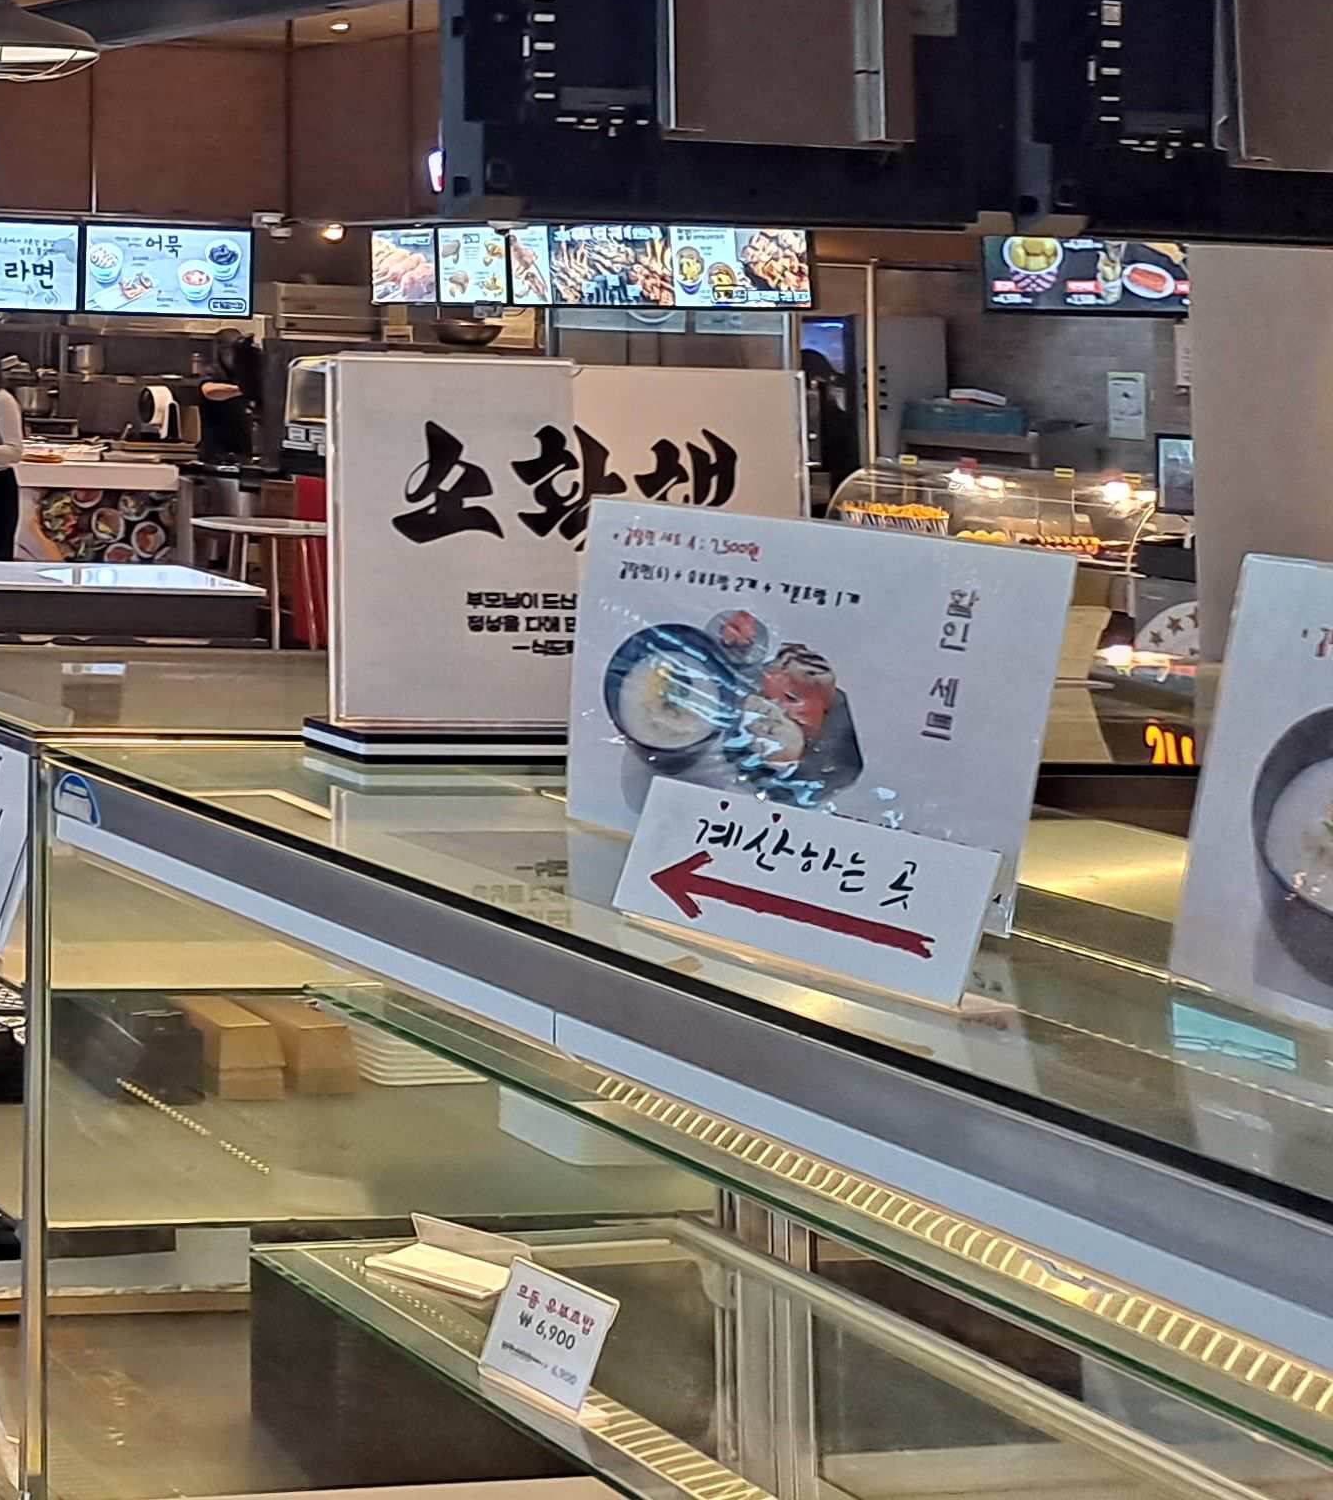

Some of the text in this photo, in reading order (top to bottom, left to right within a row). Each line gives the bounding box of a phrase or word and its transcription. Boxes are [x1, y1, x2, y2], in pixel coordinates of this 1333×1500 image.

[145, 235, 183, 259] 어묵
[4, 260, 54, 290] 라면
[467, 591, 539, 609] 부모님이
[467, 614, 520, 632] 정성을
[524, 615, 560, 632] 다해
[920, 587, 980, 742] 할인 세트
[694, 816, 919, 911] 계산하는 곳
[535, 1319, 576, 1350] 6,900
